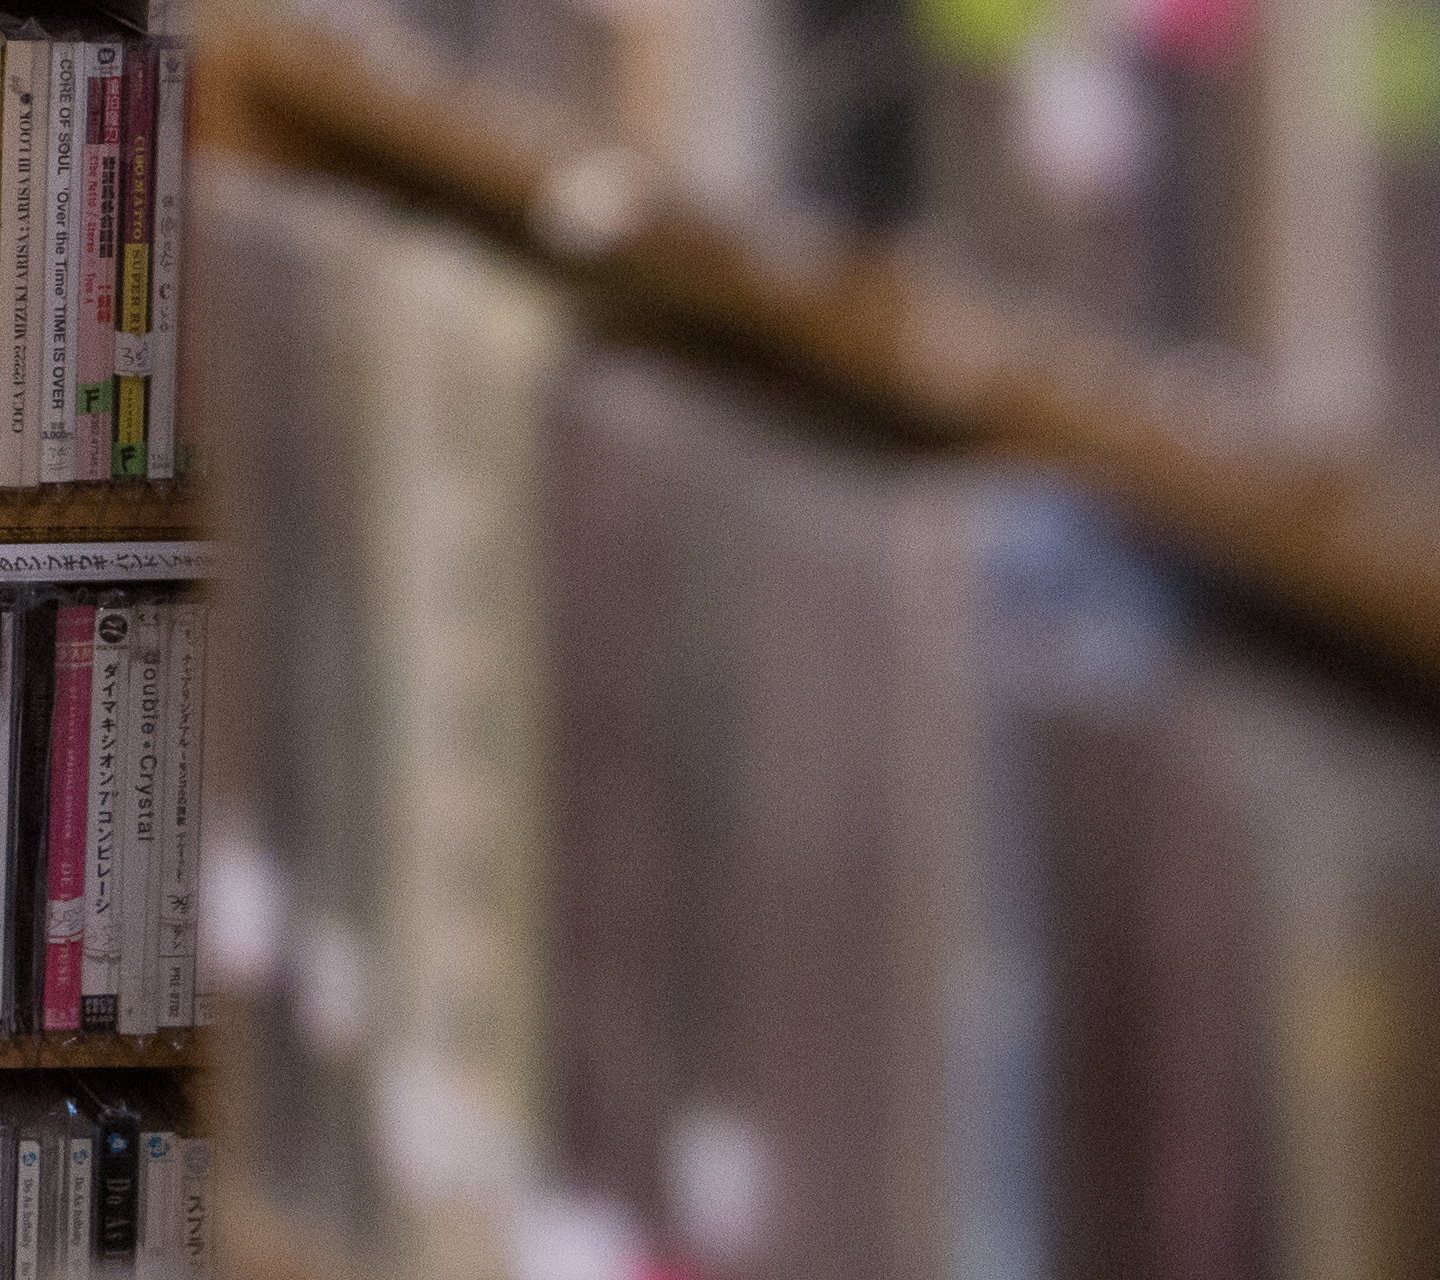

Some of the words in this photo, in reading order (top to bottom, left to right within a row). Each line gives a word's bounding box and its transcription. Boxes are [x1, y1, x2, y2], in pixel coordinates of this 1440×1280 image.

[58, 58, 72, 103] CORE
[18, 109, 33, 153] LOOK
[57, 107, 72, 129] OF
[18, 157, 31, 174] III
[56, 132, 71, 175] SOUL
[17, 177, 31, 222] ARISA
[54, 231, 68, 255] the
[13, 286, 28, 340] MIZUKI
[53, 305, 67, 343] TIME
[12, 344, 26, 385] 12222
[52, 347, 66, 362] IS
[51, 366, 66, 409] OVER
[11, 388, 25, 435] COCA
[135, 755, 158, 843] Crystal
